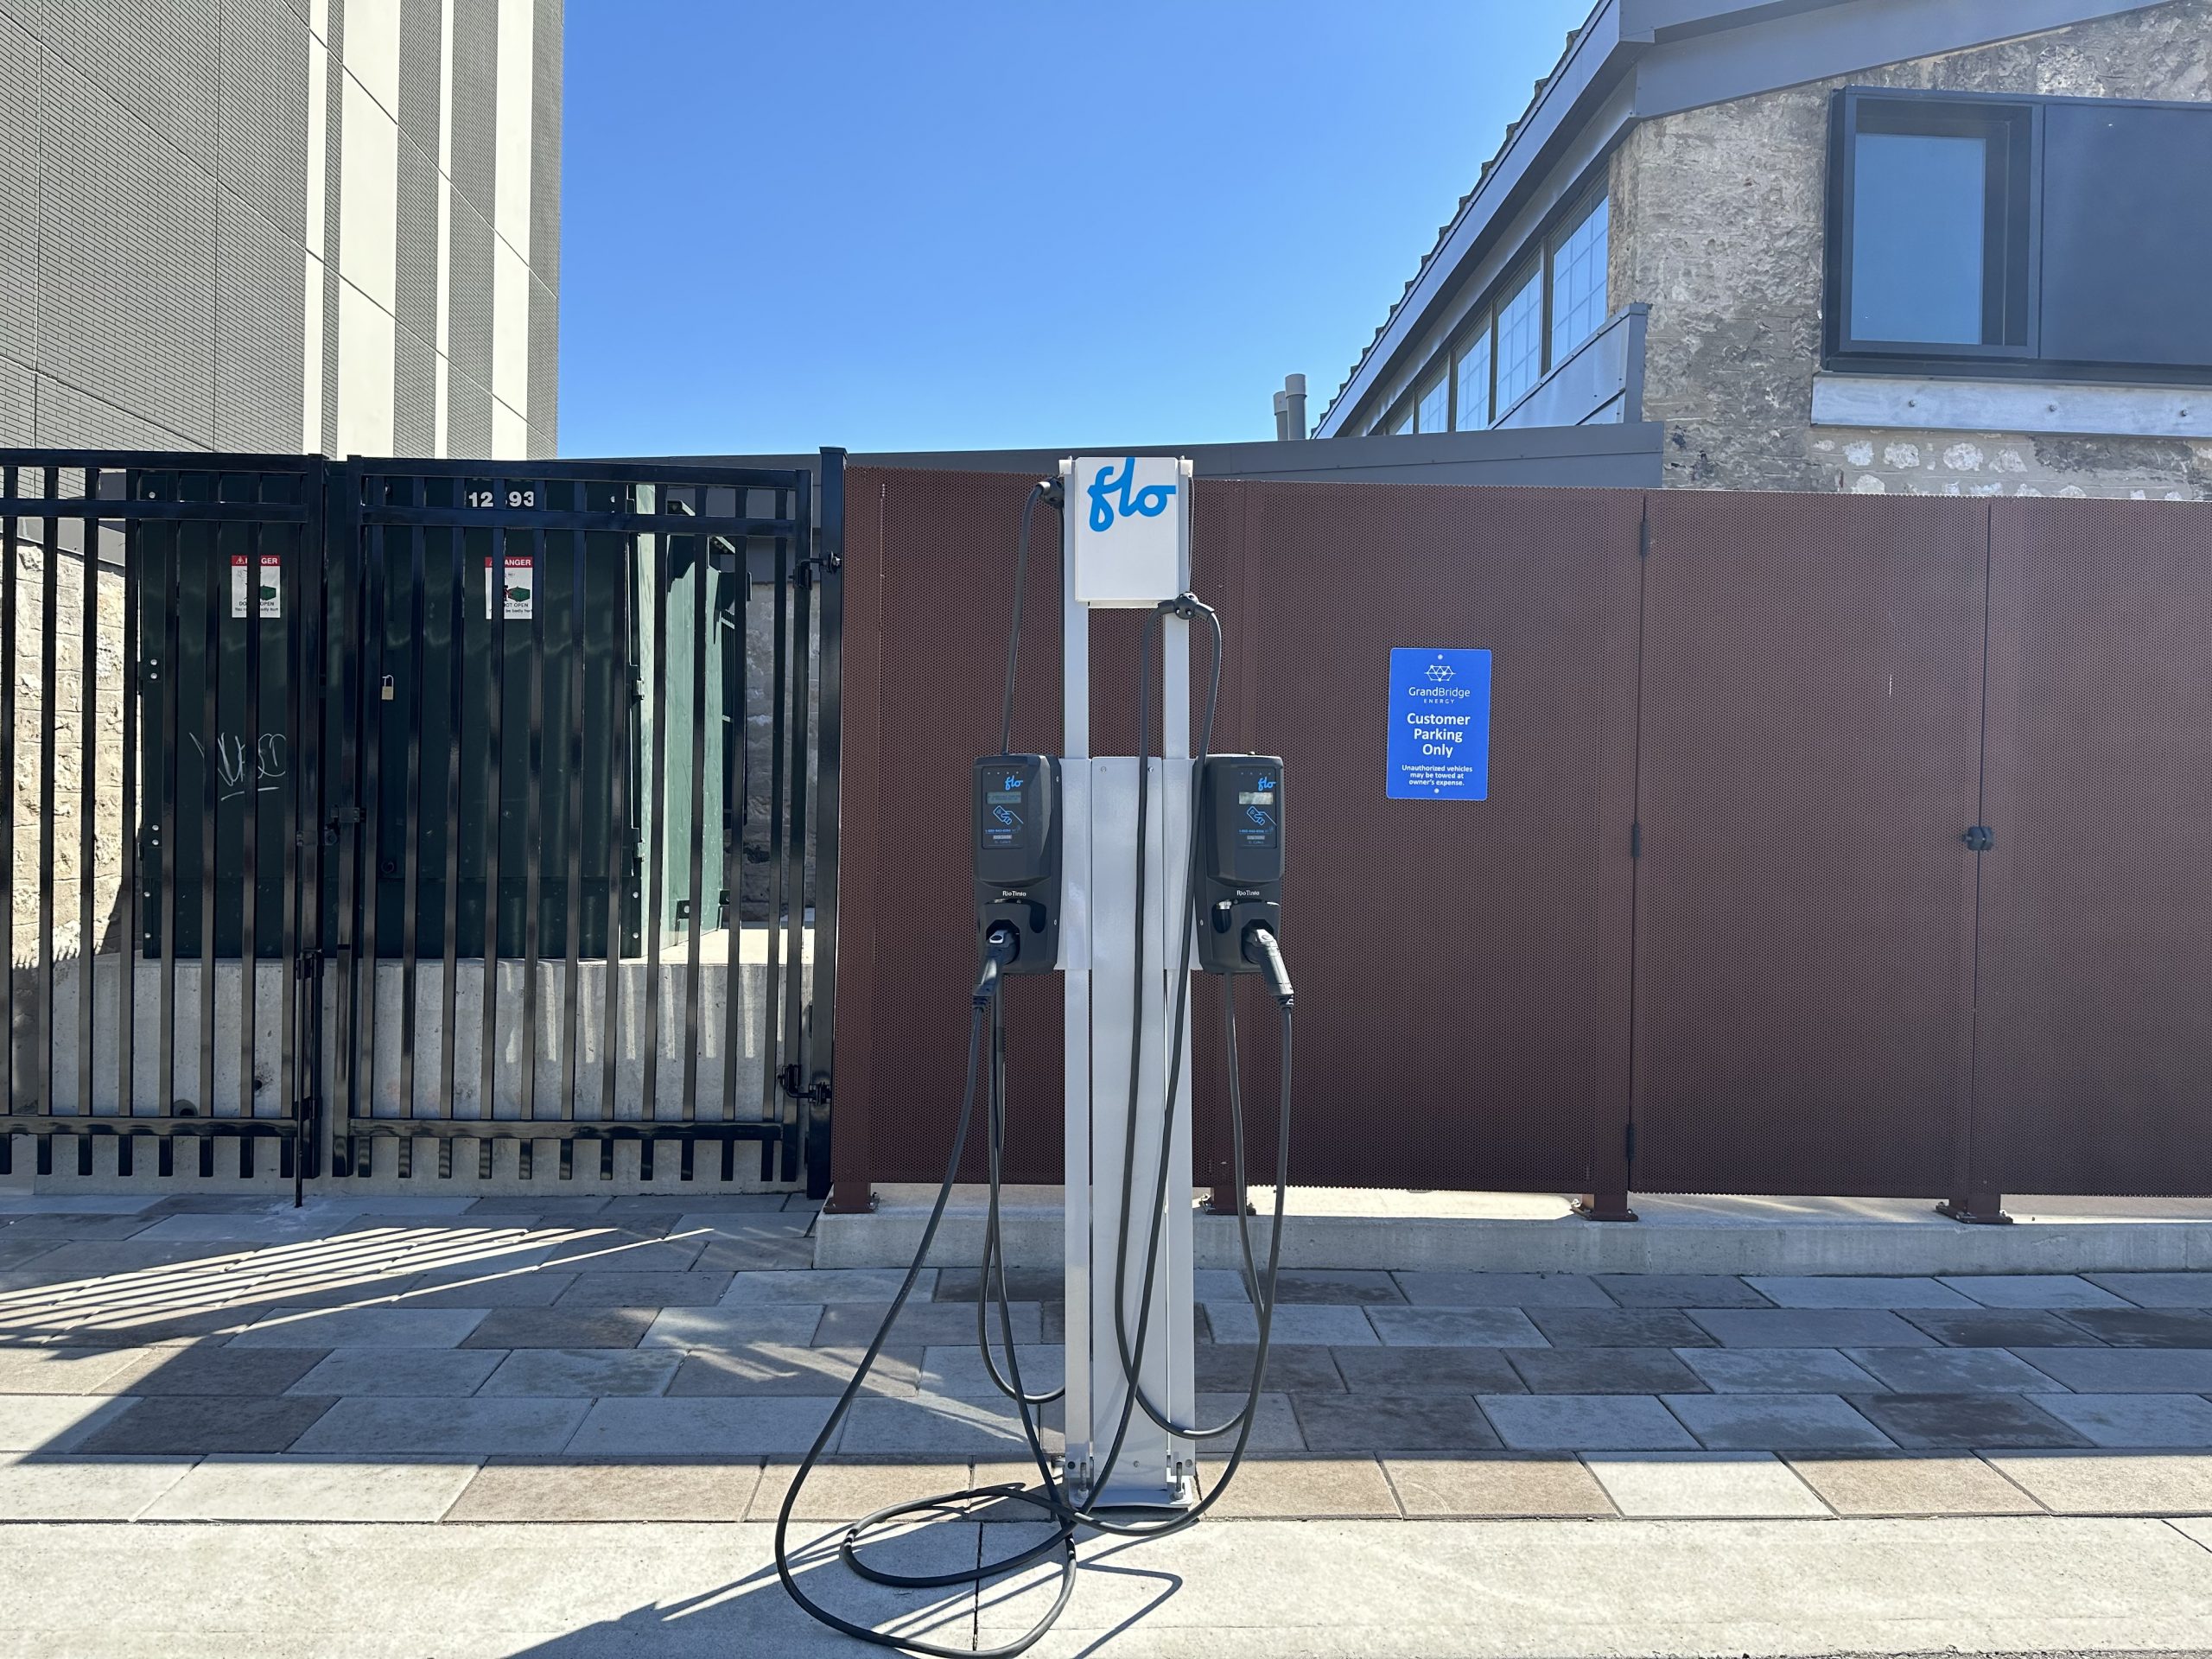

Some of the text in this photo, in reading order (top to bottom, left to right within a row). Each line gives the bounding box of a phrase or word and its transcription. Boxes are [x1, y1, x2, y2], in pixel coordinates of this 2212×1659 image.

[468, 491, 535, 507] 1293
[1087, 456, 1177, 532] flo
[1408, 686, 1471, 699] GrandBridge
[1407, 712, 1471, 726] Customer
[1414, 728, 1464, 743] Parking
[1422, 743, 1453, 759] Only
[1004, 774, 1024, 791] flo
[1257, 776, 1276, 791] flo
